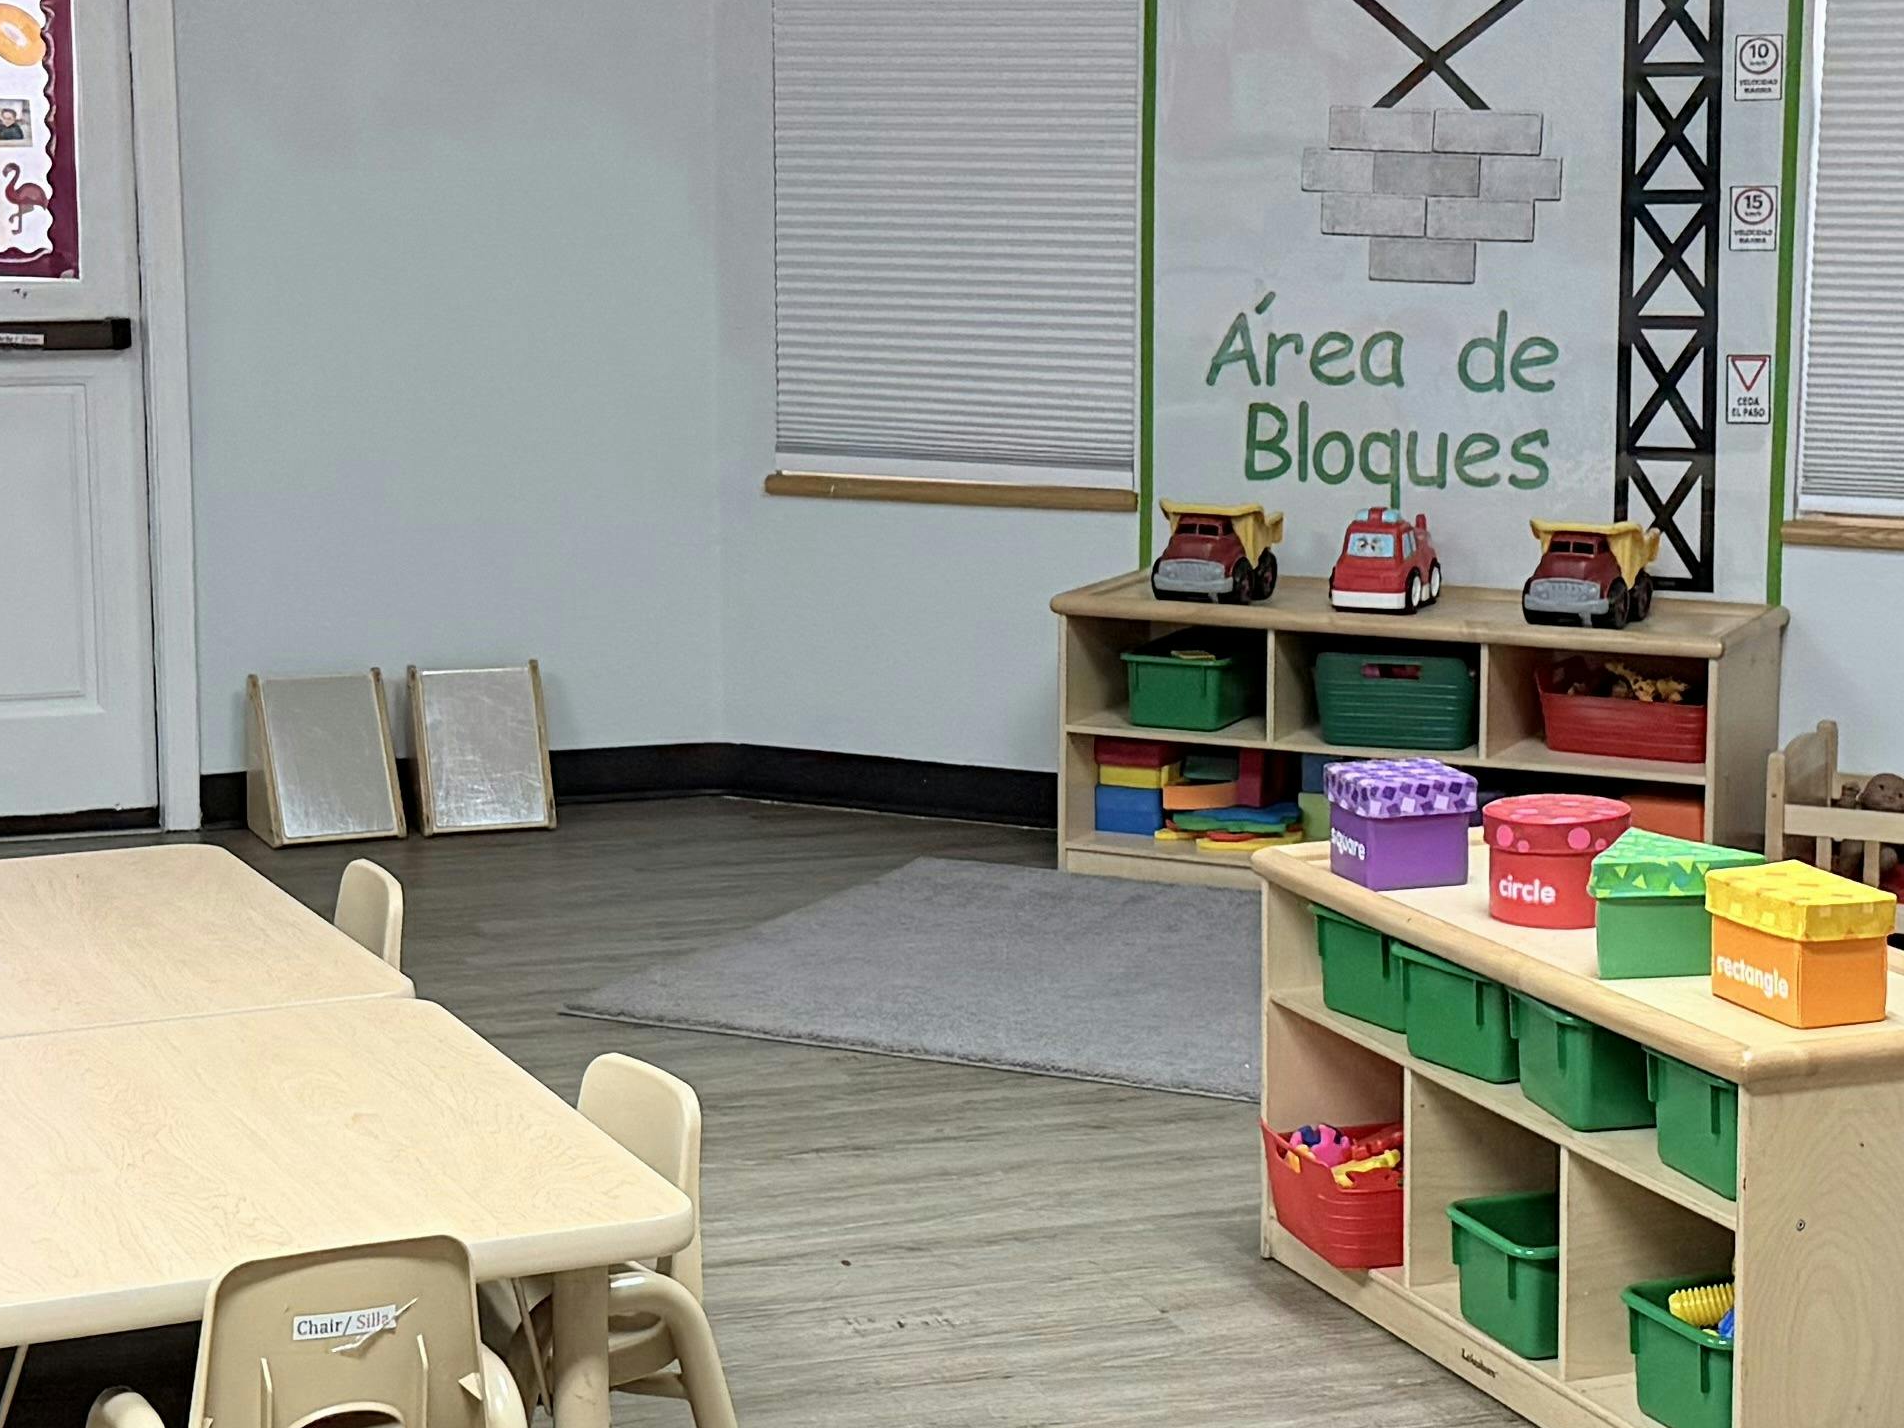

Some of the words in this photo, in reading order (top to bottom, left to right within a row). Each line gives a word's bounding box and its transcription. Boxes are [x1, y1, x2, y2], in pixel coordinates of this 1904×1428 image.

[1749, 43, 1769, 59] 10
[1744, 194, 1763, 209] 15
[1206, 291, 1405, 387] Área
[1457, 310, 1560, 393] de
[1732, 408, 1741, 417] EL
[1743, 407, 1766, 418] PASO
[1737, 397, 1760, 406] CEDA
[1244, 400, 1552, 510] Bloques
[1331, 827, 1366, 861] square
[1498, 874, 1557, 905] circle
[1716, 955, 1790, 1000] rectangle
[296, 1315, 352, 1336] Chair/
